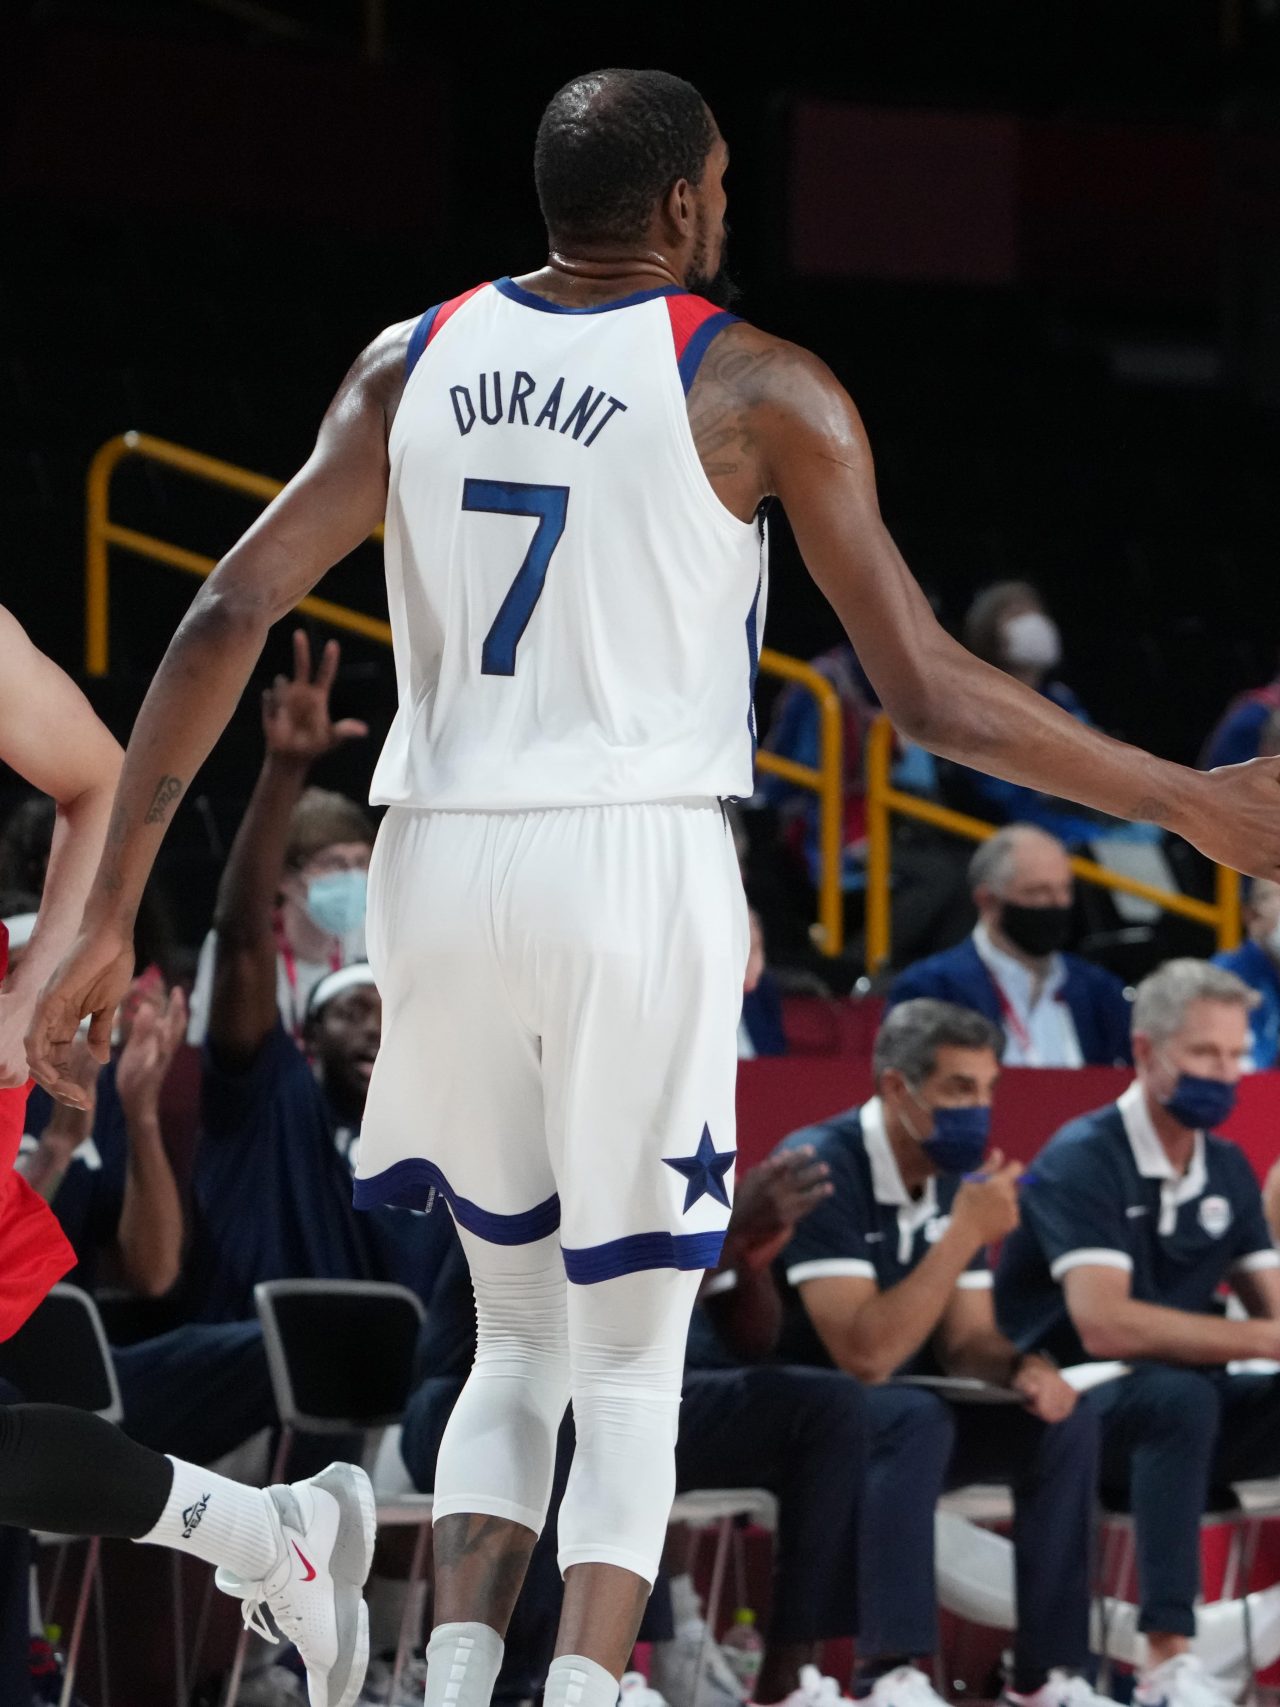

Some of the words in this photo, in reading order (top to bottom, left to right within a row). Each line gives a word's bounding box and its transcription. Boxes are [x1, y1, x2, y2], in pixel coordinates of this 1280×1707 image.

[449, 370, 628, 448] DURANT
[461, 477, 570, 677] 7
[181, 1493, 211, 1539] PEAK
